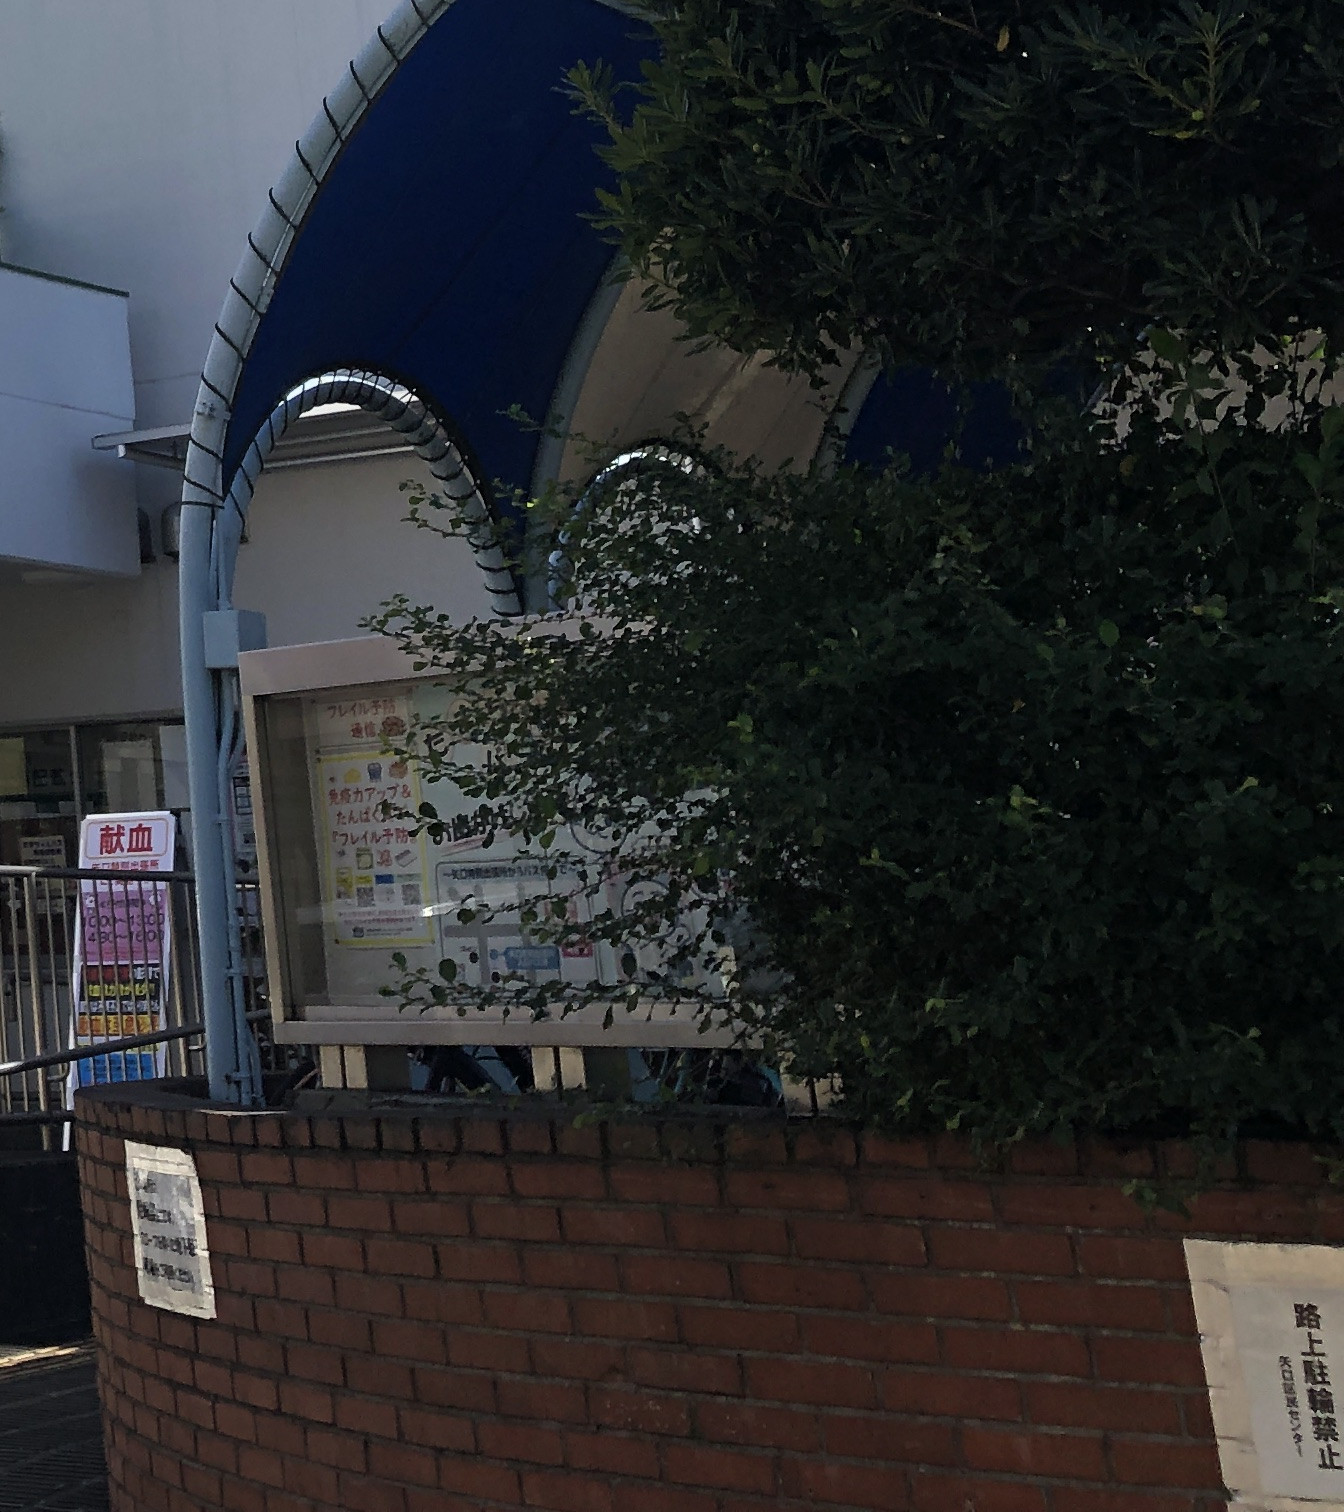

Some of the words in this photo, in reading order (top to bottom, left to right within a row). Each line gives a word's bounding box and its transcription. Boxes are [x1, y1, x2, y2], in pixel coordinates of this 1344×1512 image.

[100, 823, 153, 855] 献血
[1293, 1302, 1344, 1471] 路上駐輪禁止
